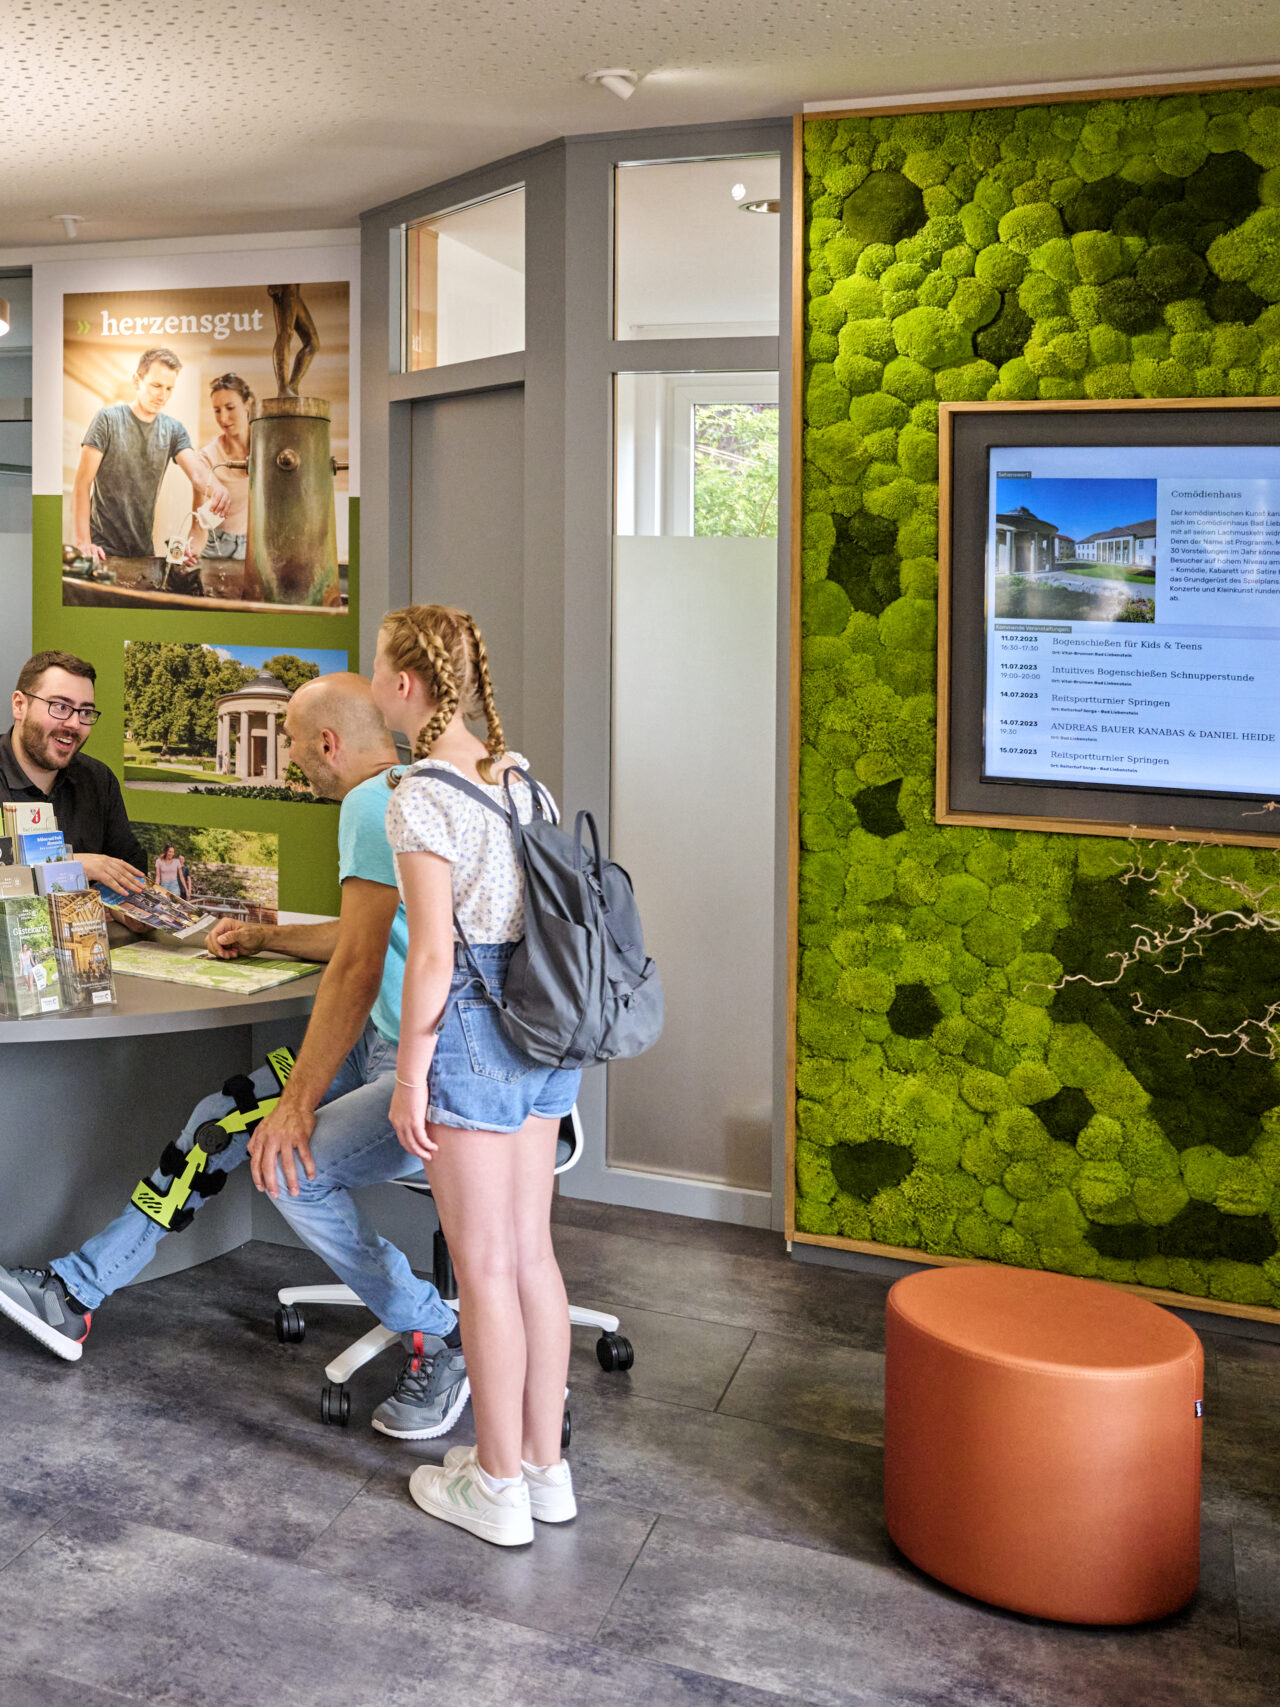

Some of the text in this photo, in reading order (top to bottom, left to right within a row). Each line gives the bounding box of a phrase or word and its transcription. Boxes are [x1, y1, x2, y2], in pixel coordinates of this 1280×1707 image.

[100, 308, 264, 340] herzensgut
[1171, 490, 1242, 499] Comödienhaus
[1184, 509, 1244, 517] komödiantischen
[1181, 548, 1229, 556] Vorstellungen
[1184, 576, 1228, 585] Grundgerüst
[1052, 637, 1202, 650] Bogenschießen für Kids & Teens
[1051, 665, 1255, 682] Intuitives Bogenschießen Schnupperstunde
[1000, 691, 1039, 699] 14.07.2023
[1051, 694, 1171, 708] Reitsportturnier Springen
[1050, 722, 1276, 742] ANDREAS BAUER KANABAS & DANIEL HEIDE
[1000, 747, 1038, 755] 15.07.2023
[1050, 750, 1170, 766] Reitsportturnier Springen
